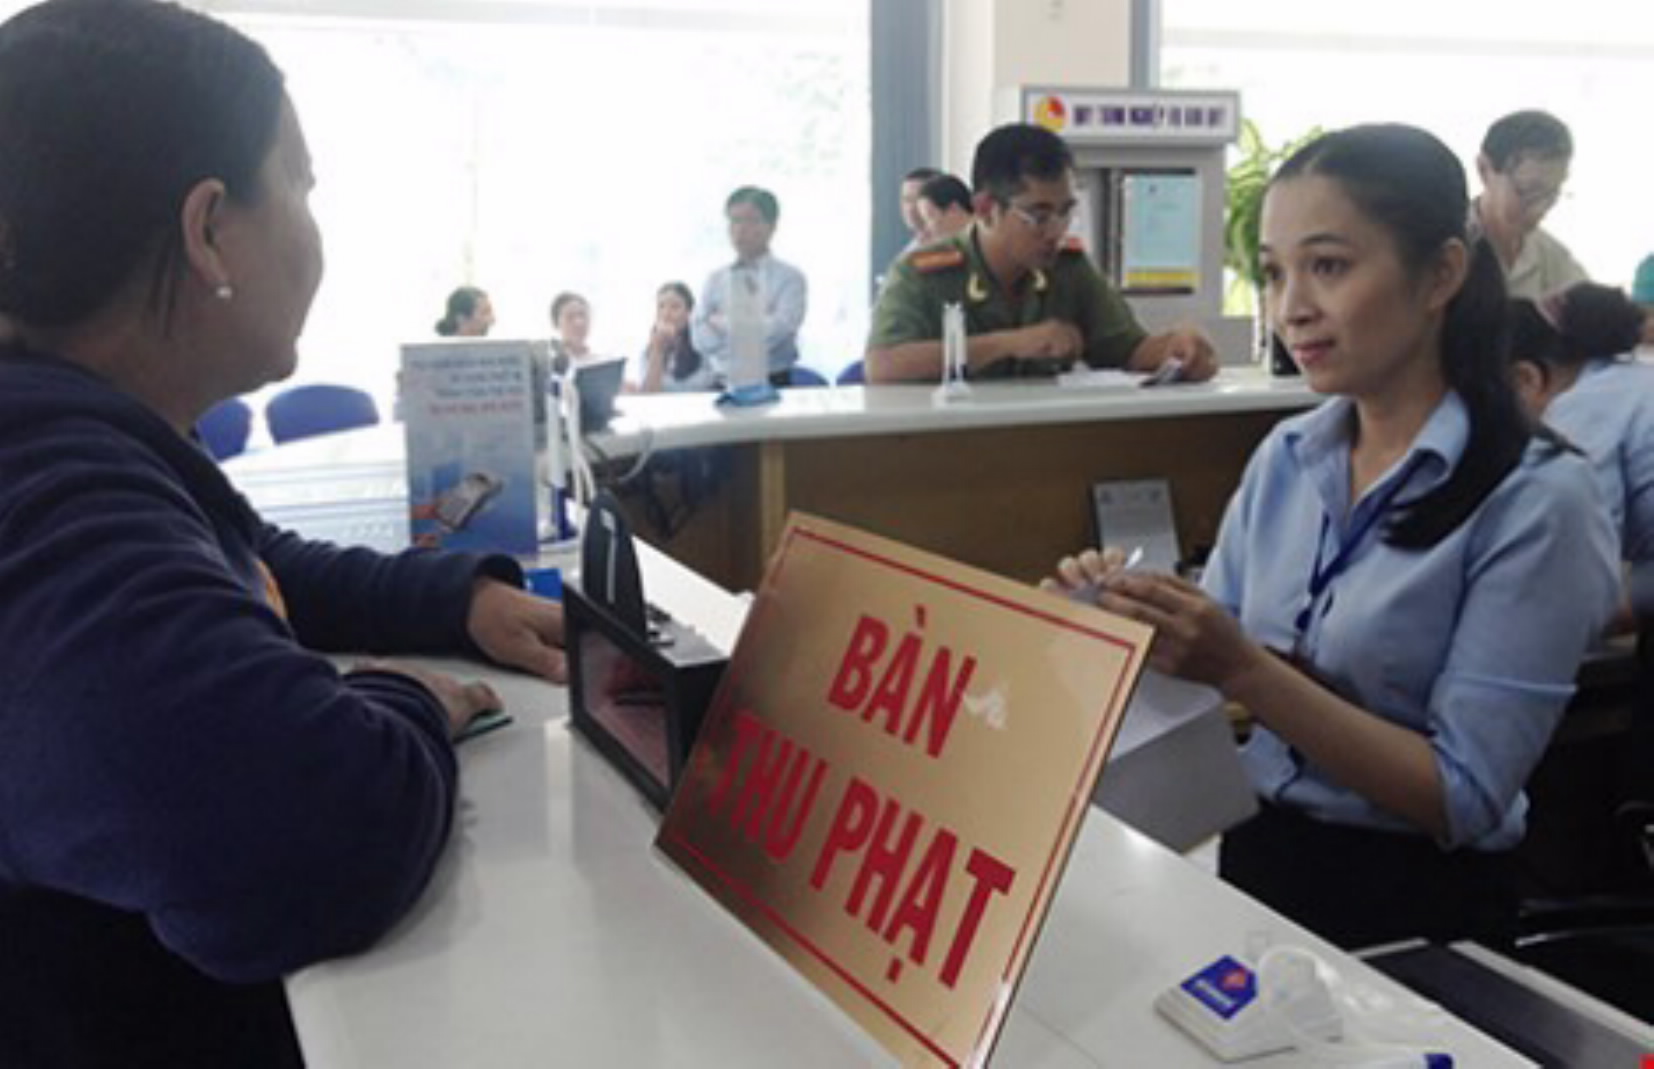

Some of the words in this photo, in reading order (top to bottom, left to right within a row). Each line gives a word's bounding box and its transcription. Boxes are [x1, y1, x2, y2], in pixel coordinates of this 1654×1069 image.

[828, 605, 976, 758] BÀN
[709, 708, 828, 862] THU
[809, 777, 1017, 989] PHẠT
